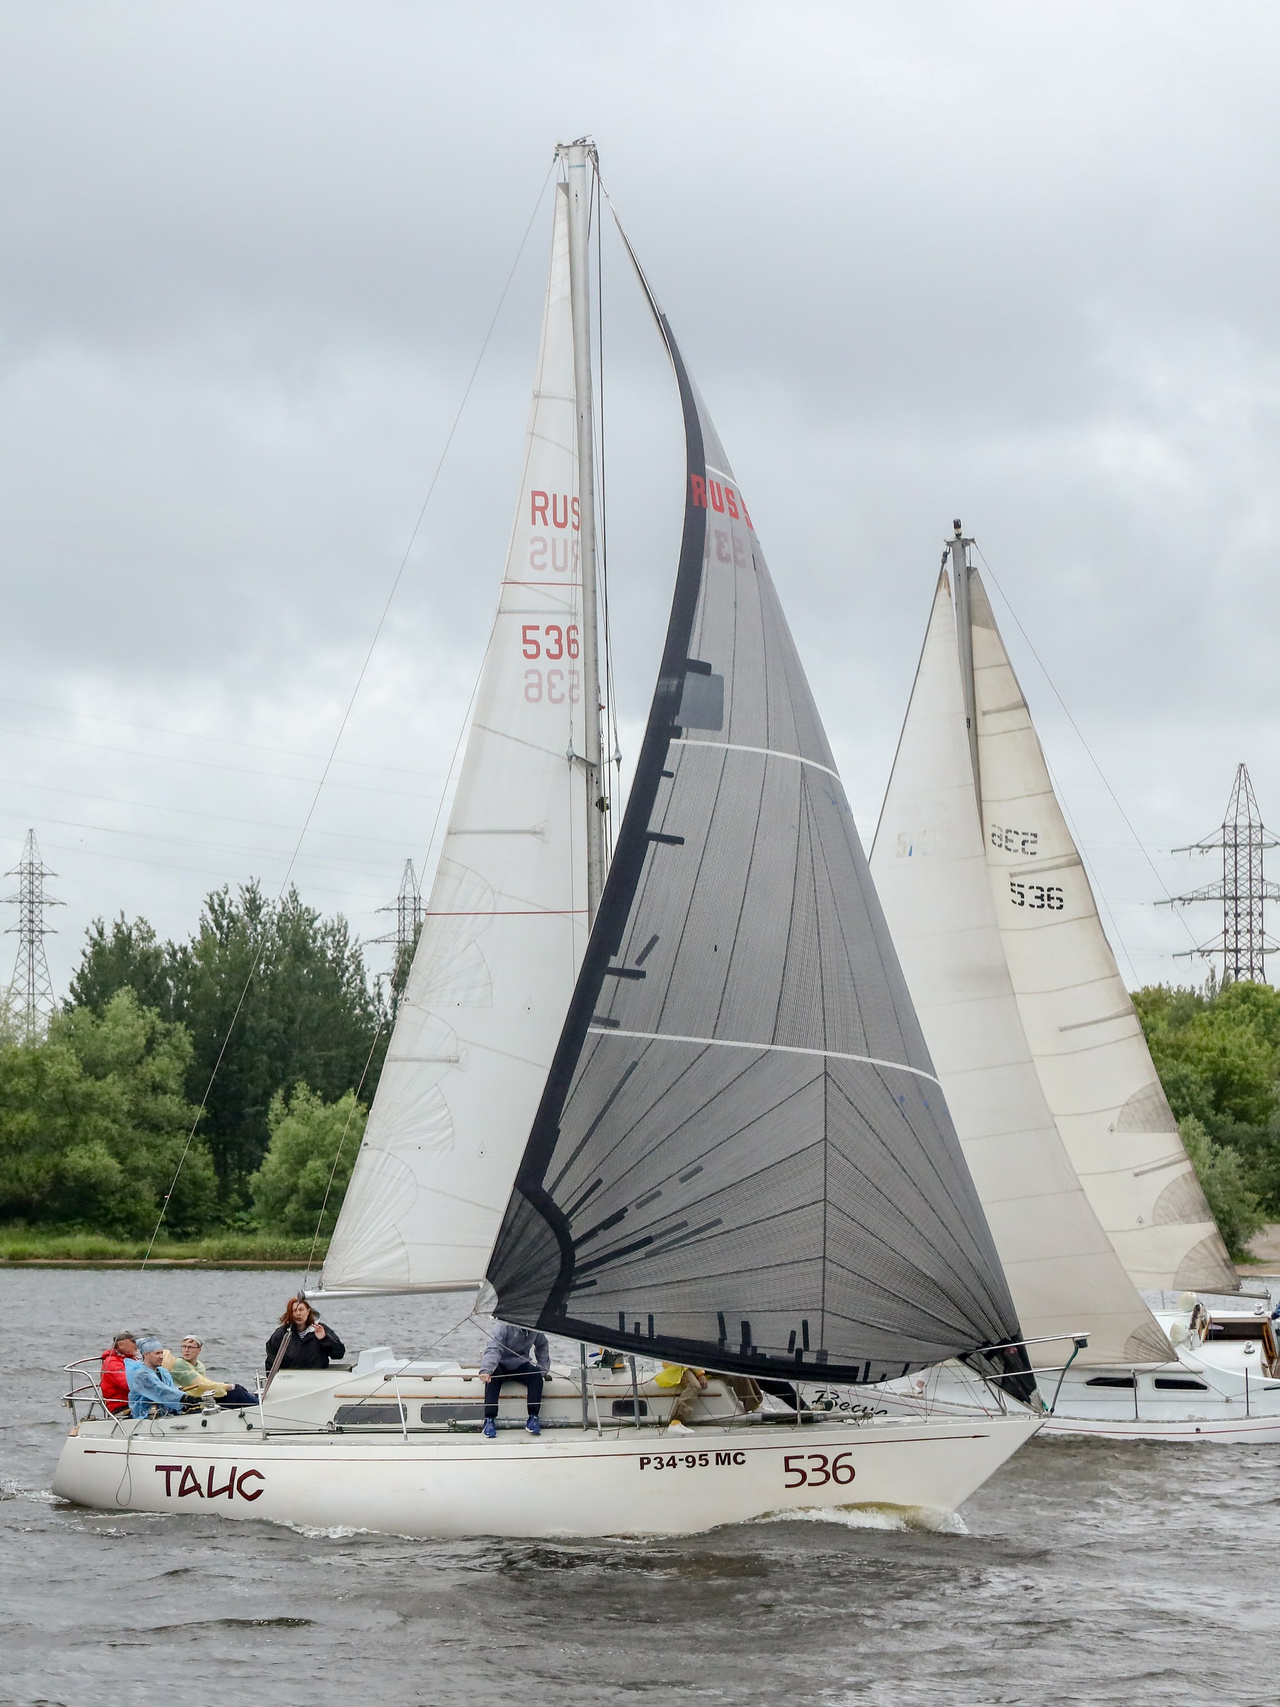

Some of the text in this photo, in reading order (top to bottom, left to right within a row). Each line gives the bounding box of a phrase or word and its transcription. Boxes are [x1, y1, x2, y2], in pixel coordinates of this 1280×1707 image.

[531, 490, 580, 532] RUS
[691, 474, 739, 520] RUS
[522, 624, 580, 660] 536
[1010, 881, 1064, 911] 536
[783, 1451, 856, 1489] 536
